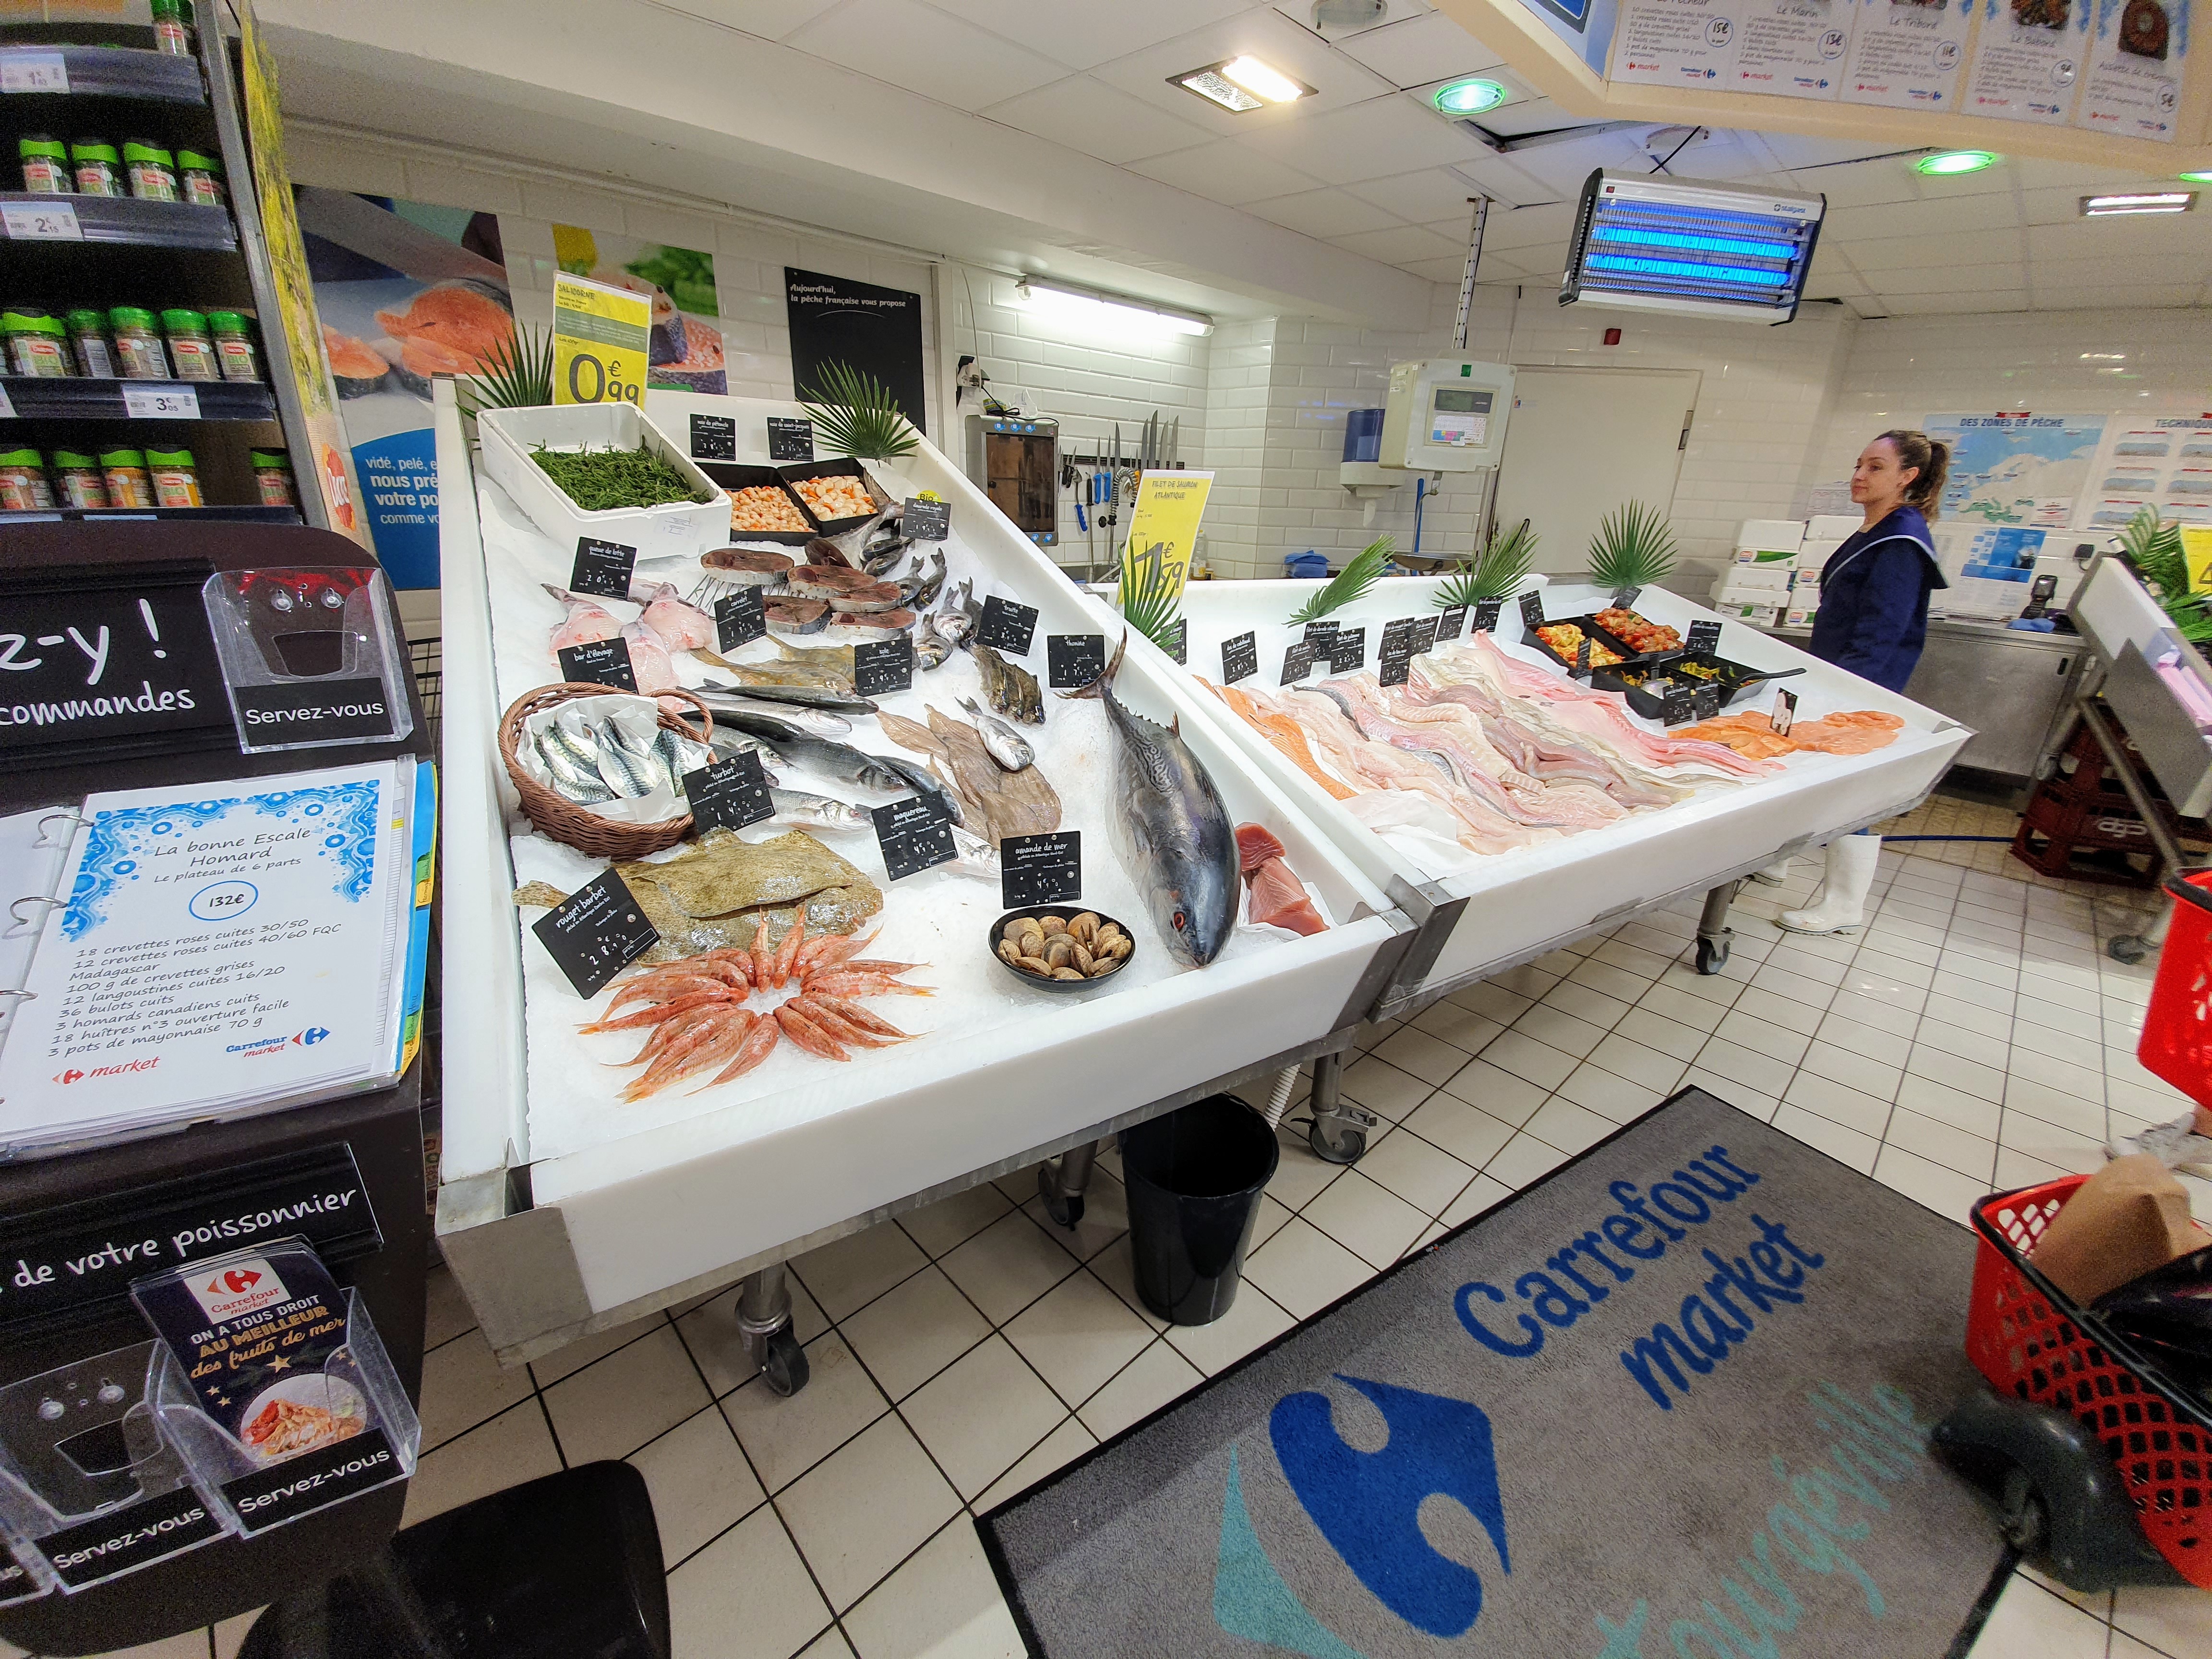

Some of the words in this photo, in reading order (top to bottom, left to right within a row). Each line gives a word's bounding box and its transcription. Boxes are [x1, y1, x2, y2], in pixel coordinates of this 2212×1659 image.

[801, 294, 823, 304] pêche
[825, 296, 859, 306] française
[879, 300, 906, 308] propose
[1960, 418, 1979, 427] DES
[1981, 419, 2012, 427] ZONES
[2016, 419, 2027, 427] DE
[365, 456, 396, 471] vidé,
[398, 457, 428, 471] pelé,
[370, 475, 411, 488] nous
[374, 492, 417, 506] votre
[380, 514, 425, 524] comme
[139, 598, 167, 659] !
[574, 653, 585, 662] bar
[0, 680, 195, 726] commandes
[246, 701, 384, 725] Servez-vous
[710, 765, 735, 781] turbot
[893, 805, 928, 821] maquereau
[154, 846, 178, 857] La
[187, 838, 245, 853] bonne
[254, 828, 311, 845] Escale
[1015, 843, 1042, 855] amande
[1044, 842, 1052, 851] de
[190, 846, 273, 867] Homard
[154, 875, 169, 883] Le
[174, 868, 225, 883] plateau
[230, 864, 246, 873] de
[265, 857, 301, 871] parts
[209, 894, 244, 907] 132€
[555, 903, 582, 929] rouget
[577, 885, 607, 910] barbet
[73, 960, 95, 969] 12
[101, 950, 168, 966] crevettes
[173, 944, 207, 957] roses
[213, 938, 253, 951] cuites
[258, 930, 307, 943] 40/60
[313, 924, 342, 936] FQC
[77, 948, 98, 957] 18
[104, 939, 170, 955] crevettes
[175, 934, 210, 945] roses
[216, 926, 255, 940] cuites
[260, 919, 309, 933] 30/50
[66, 982, 101, 993] 100
[104, 981, 115, 991] g
[120, 976, 138, 986] de
[144, 967, 214, 983] crevettes
[215, 960, 255, 976] grises
[69, 963, 160, 981] Madagascar
[63, 996, 85, 1006] 12
[91, 982, 183, 1002] langoustines
[188, 974, 230, 988] cuites
[235, 966, 285, 981] 16/20
[55, 1022, 66, 1031] 3
[73, 1010, 143, 1028] homards
[148, 1000, 221, 1018] canadiens
[227, 993, 261, 1005] cuits
[59, 1008, 82, 1018] 36
[88, 1000, 134, 1014] bulots
[140, 995, 175, 1008] cuits
[51, 1034, 74, 1045] 18
[81, 1025, 137, 1041] huîtres
[142, 1020, 169, 1031] n°3
[175, 1008, 247, 1026] ouverture
[252, 998, 289, 1014] facile
[48, 1048, 59, 1058] 3
[65, 1042, 101, 1058] pots
[106, 1037, 125, 1049] de
[132, 1023, 221, 1045] mayonnaise
[228, 1019, 249, 1029] 70
[252, 1017, 263, 1028] g
[226, 1036, 288, 1053] Carrefour
[243, 1043, 286, 1058] market
[90, 1056, 160, 1078] market
[13, 1260, 56, 1288] de
[65, 1238, 160, 1276] votre
[172, 1189, 357, 1258] poissonnier
[1454, 1145, 1760, 1358] Carrefour
[211, 1287, 280, 1313] Carrefour
[230, 1298, 270, 1316] market
[1619, 1213, 1825, 1411] market
[190, 1330, 215, 1345] ON
[219, 1325, 231, 1336] A
[231, 1310, 274, 1332] TOUS
[276, 1295, 321, 1316] DROIT
[200, 1341, 230, 1358] AU
[231, 1306, 330, 1346] MEILLEUR
[190, 1360, 222, 1379] des
[228, 1336, 278, 1370] fruits
[281, 1330, 306, 1347] de
[309, 1318, 347, 1337] mer
[237, 1447, 390, 1514] Servez-vous
[53, 1506, 205, 1569] Servez-vous
